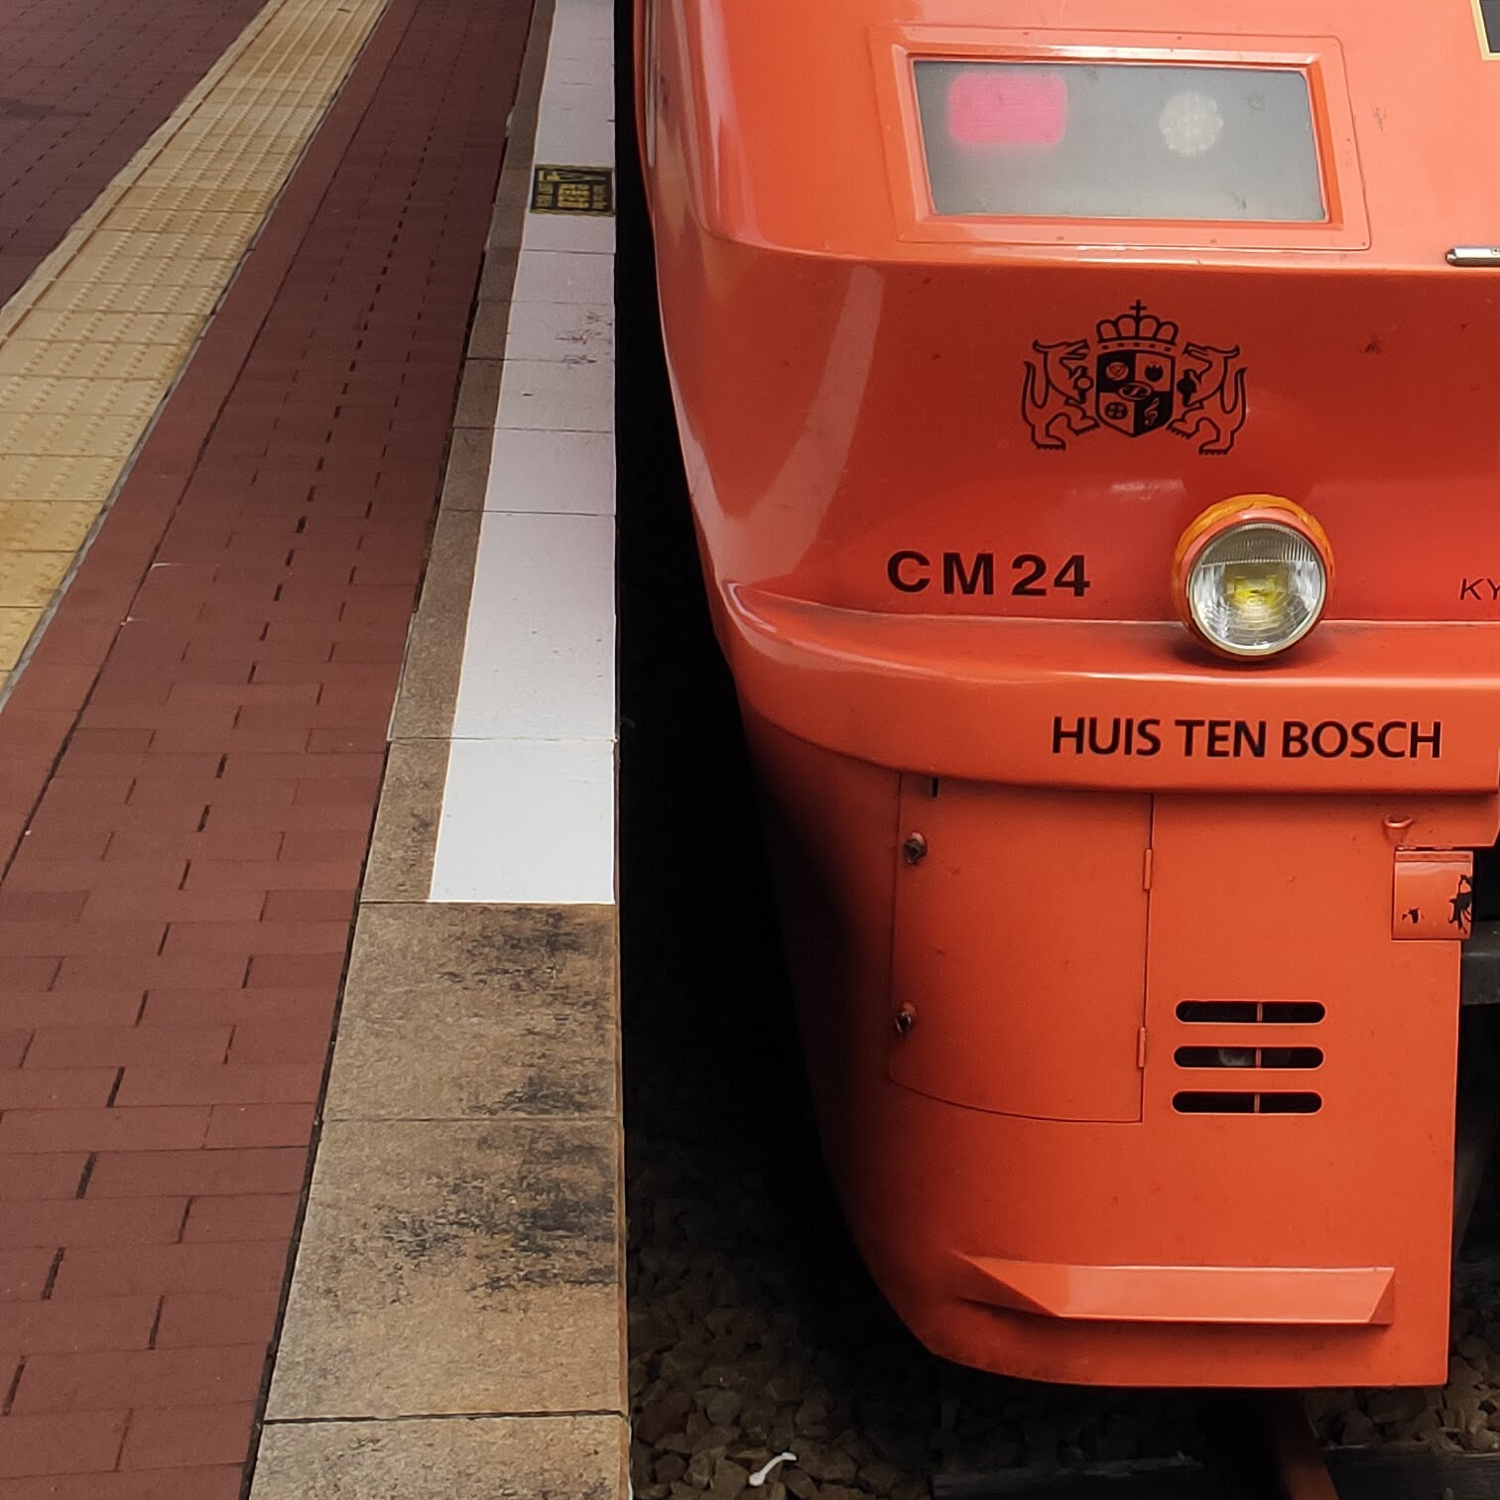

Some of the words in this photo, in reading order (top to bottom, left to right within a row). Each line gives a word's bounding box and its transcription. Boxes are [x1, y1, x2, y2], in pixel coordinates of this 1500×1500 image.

[1051, 716, 1162, 756] HUIS
[1174, 719, 1267, 757] TEN
[1281, 720, 1442, 759] BOSCH
